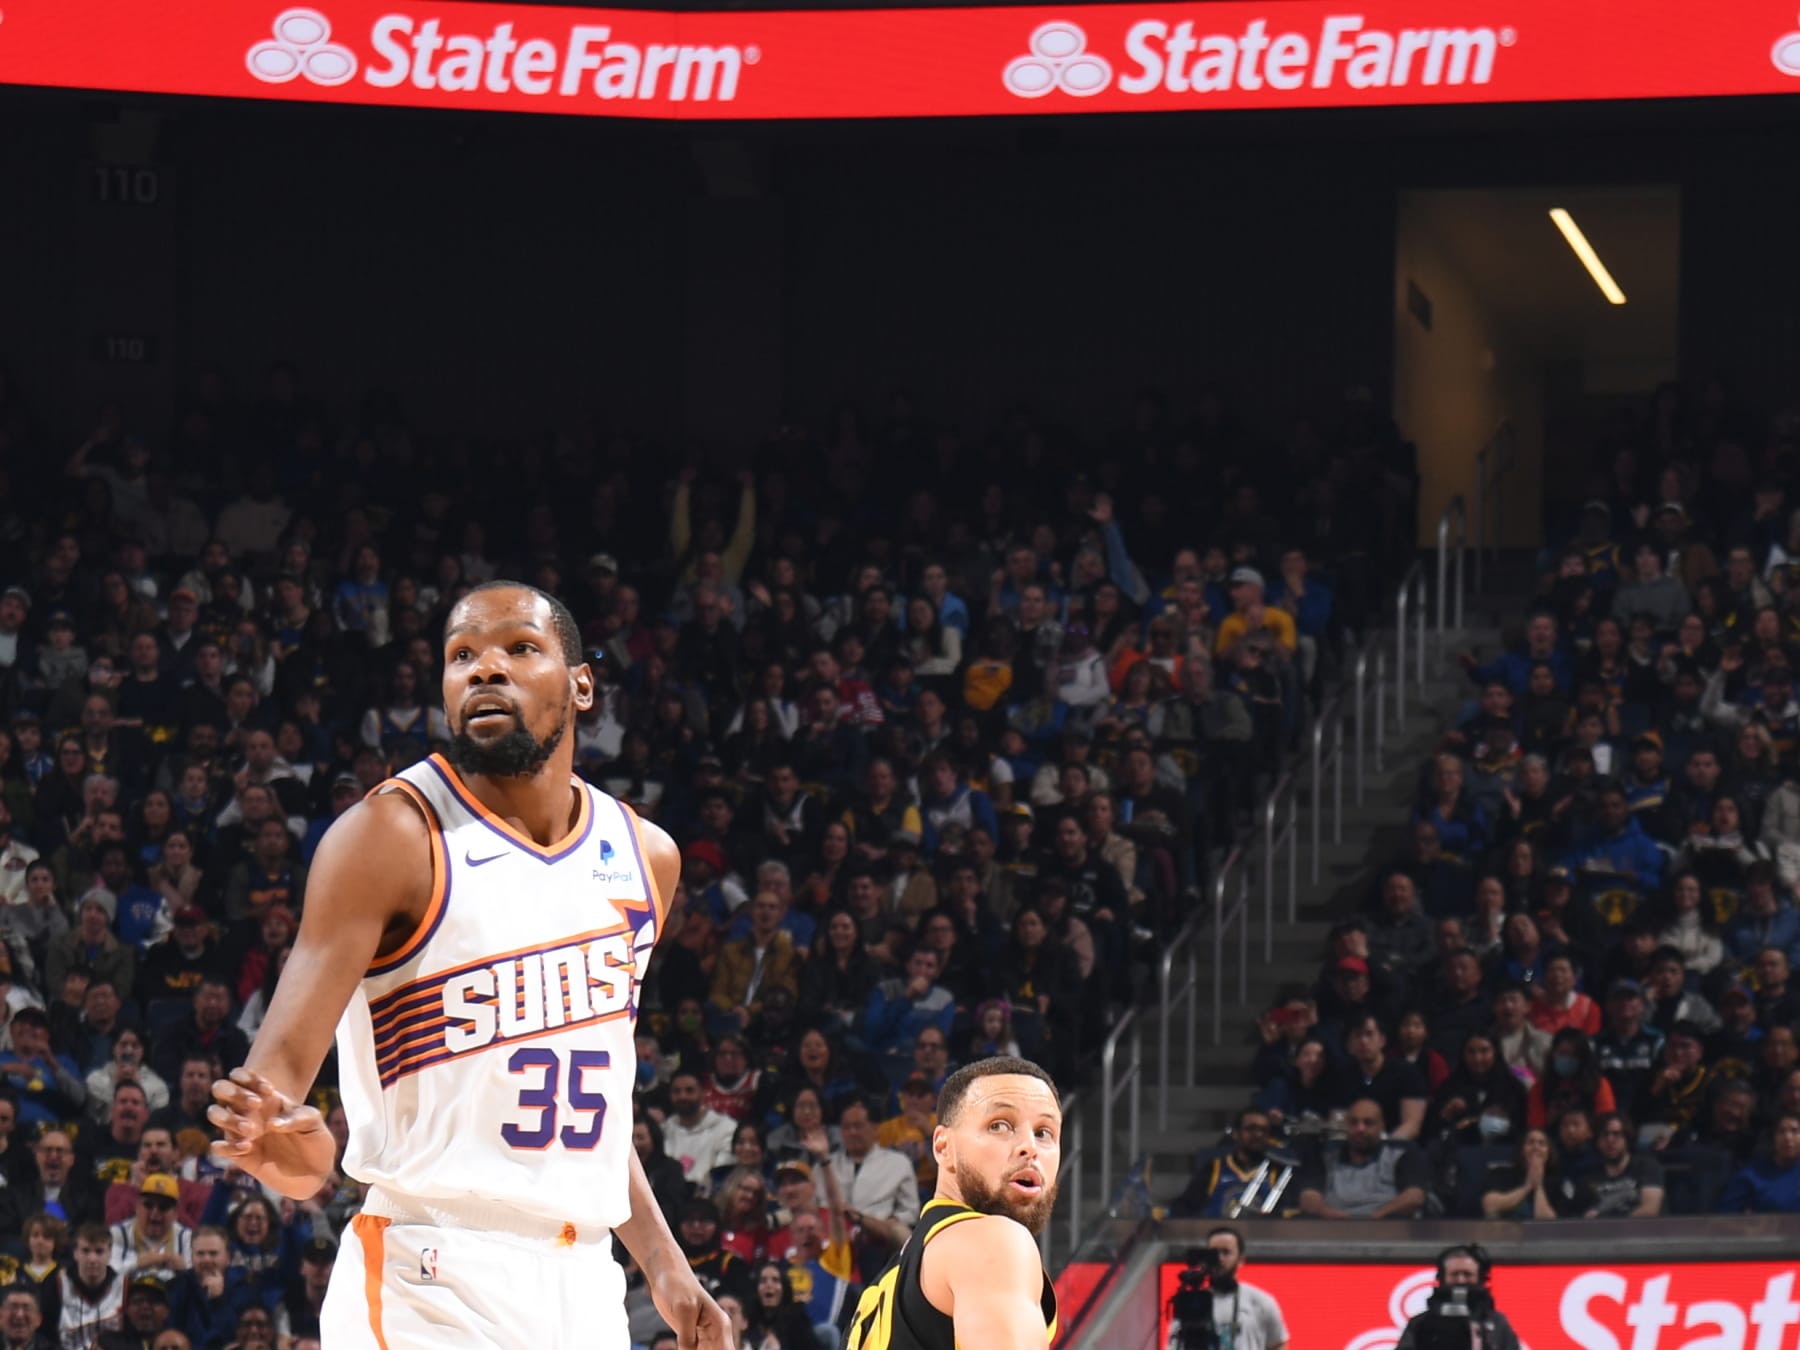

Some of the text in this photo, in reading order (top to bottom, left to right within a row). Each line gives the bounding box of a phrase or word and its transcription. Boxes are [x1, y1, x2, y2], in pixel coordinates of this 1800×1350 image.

[95, 167, 158, 204] 110
[105, 335, 145, 360] 110
[592, 869, 632, 883] PayPal
[441, 934, 632, 1054] SUNS
[500, 1047, 611, 1151] 35
